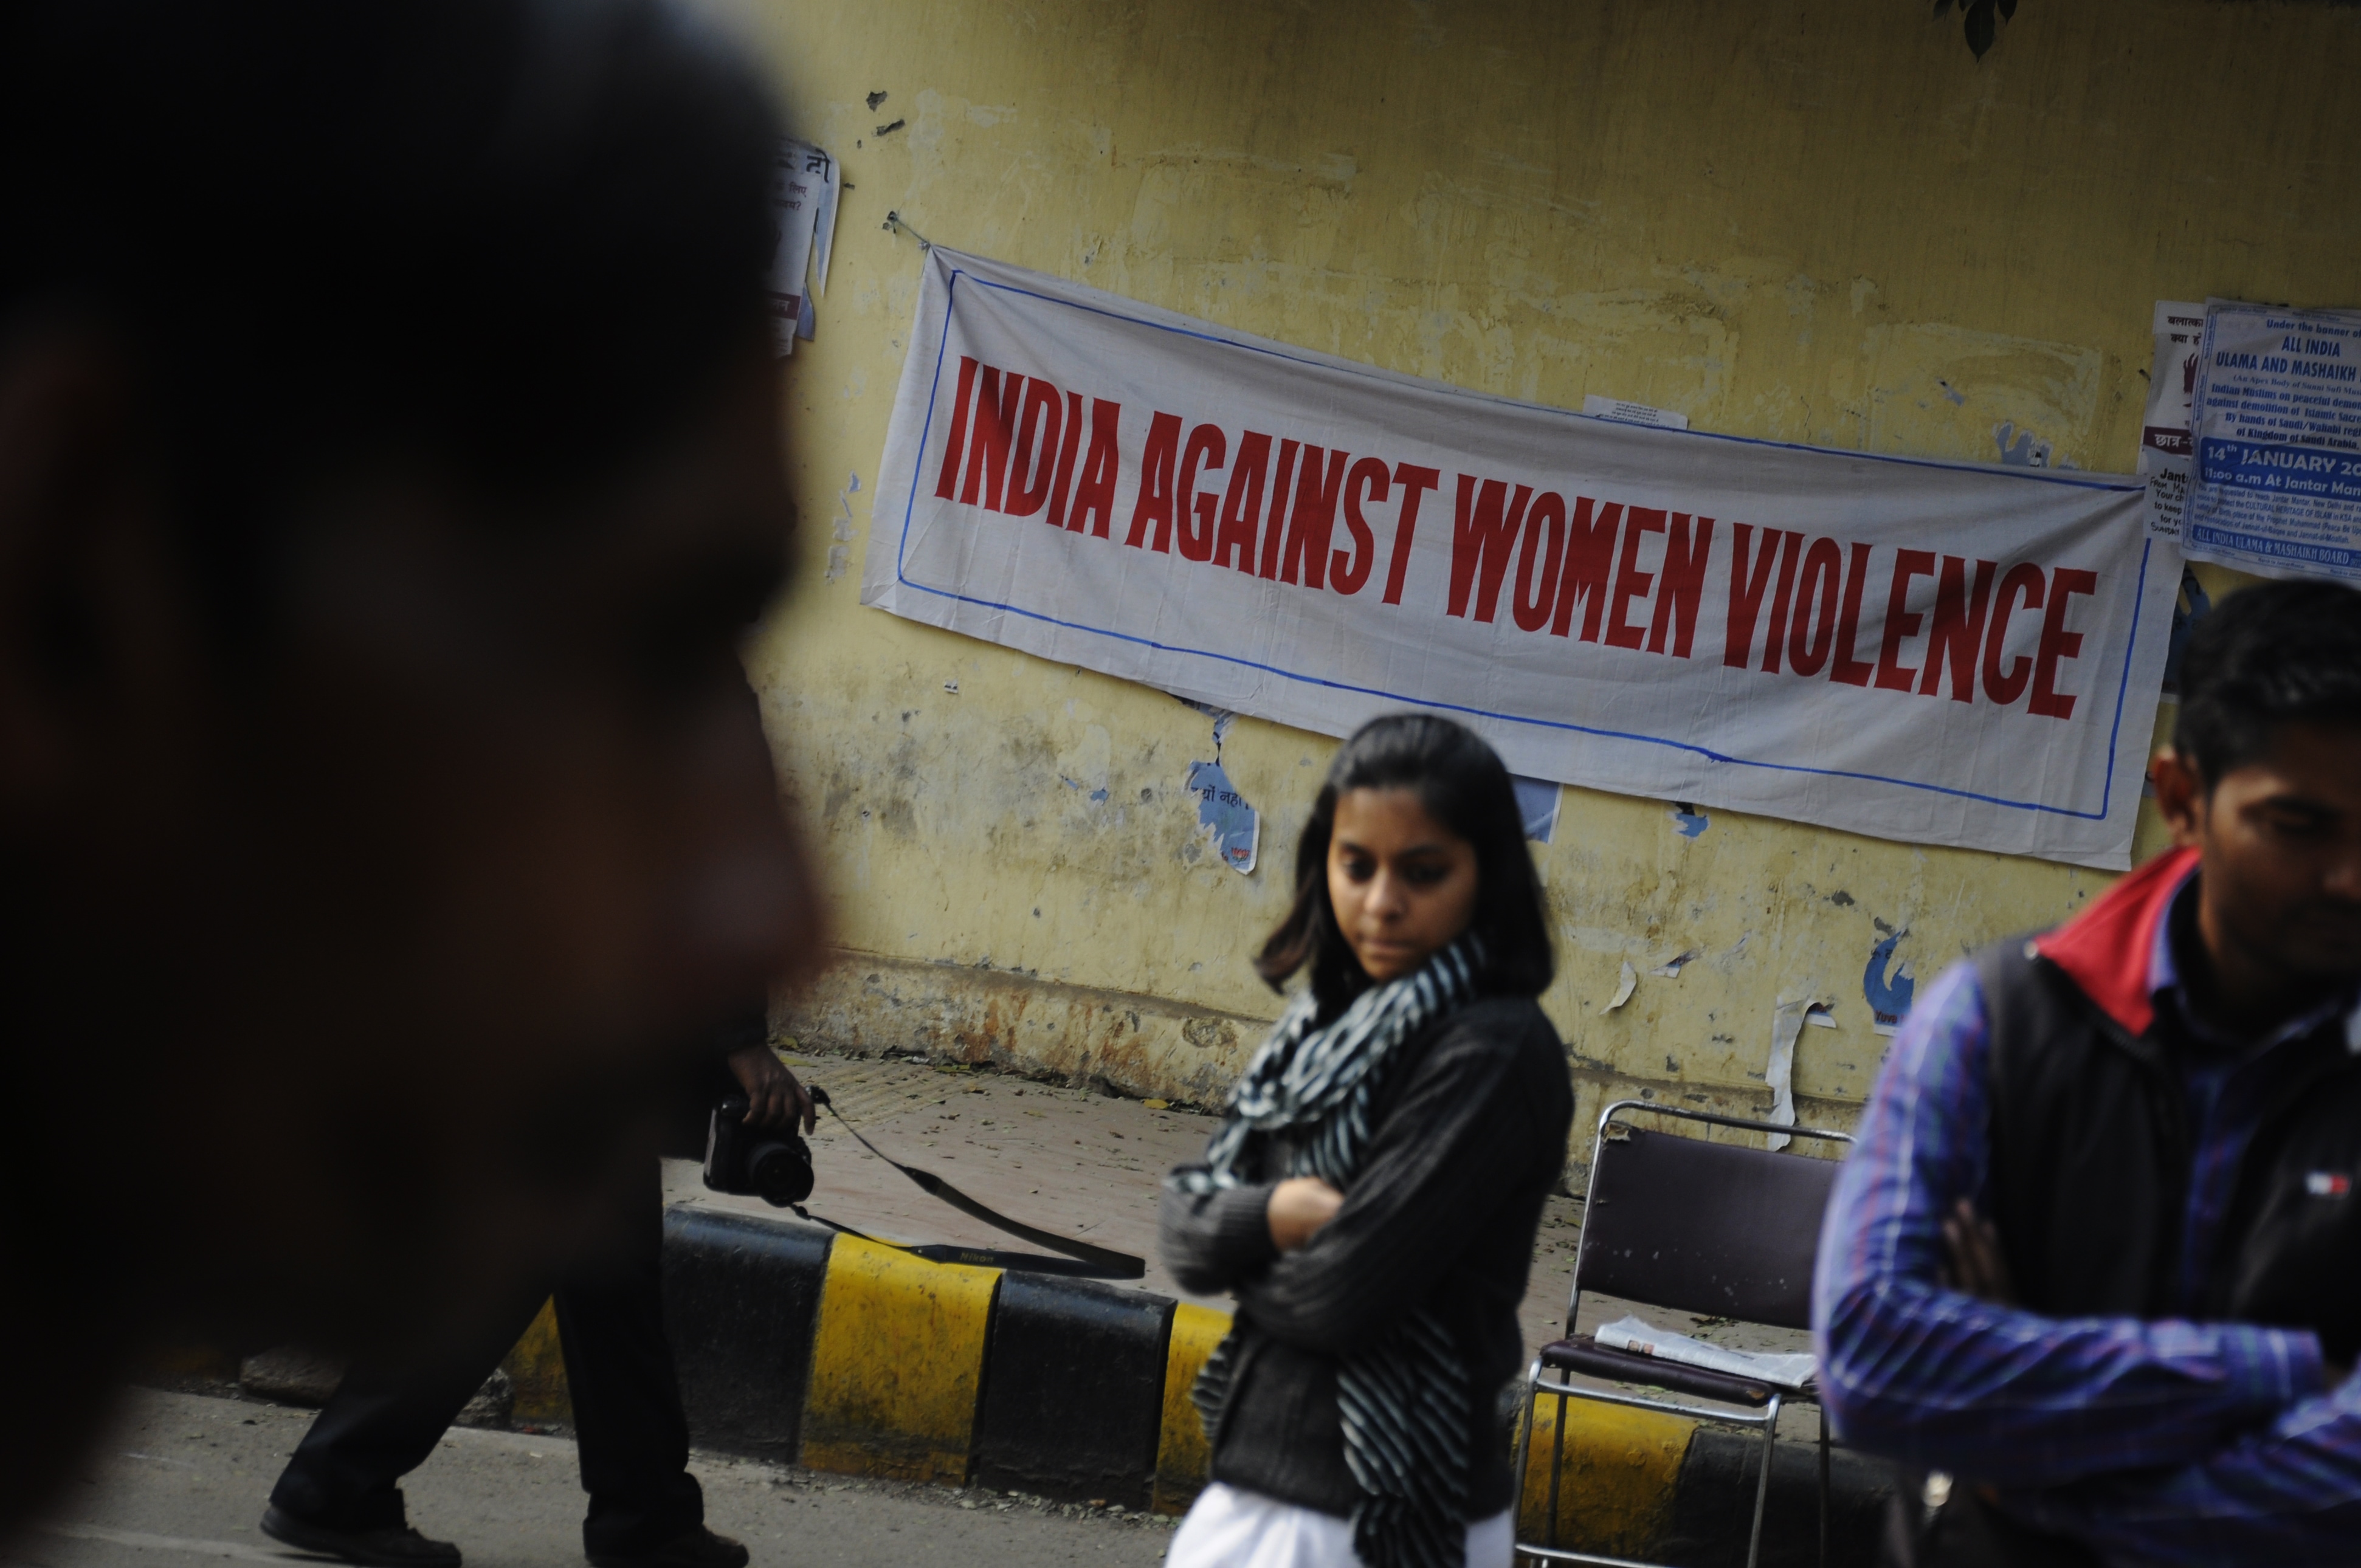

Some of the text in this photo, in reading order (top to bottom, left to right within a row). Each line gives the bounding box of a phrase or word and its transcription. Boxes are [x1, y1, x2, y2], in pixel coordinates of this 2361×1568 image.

[2170, 334, 2188, 343] क्या
[2266, 318, 2361, 338] Under the banner of
[2281, 335, 2340, 357] ALL INDIA
[2216, 351, 2357, 382] ULAMA AND MASHAIKH
[2211, 383, 2240, 395] Indian
[2242, 387, 2277, 400] Muslims
[2279, 392, 2290, 401] on
[2292, 394, 2331, 407] peaceful
[2250, 376, 2269, 385] Apex
[2271, 377, 2289, 388] Body
[2302, 382, 2324, 392] Sunni
[2207, 397, 2238, 408] against
[2241, 401, 2289, 414] demolition
[2290, 407, 2300, 416] of
[2304, 408, 2335, 420] Islamic
[2225, 411, 2236, 423] By
[2239, 413, 2265, 425] hands
[2267, 417, 2277, 427] of
[2278, 418, 2341, 435] Saudi/Wahabi
[2236, 427, 2359, 450] of Kingdom of Saudi Arabia.
[2207, 444, 2237, 461] 14th
[2241, 449, 2337, 473] JANUARY
[2204, 467, 2232, 481] 11:00
[2236, 473, 2261, 485] a.m
[2264, 474, 2282, 487] At
[2284, 476, 2328, 493] Jantar
[2156, 489, 2173, 500] Your
[2272, 495, 2289, 503] Jantar
[2327, 500, 2342, 509] Delhi
[2154, 501, 2182, 515] to keep
[2160, 514, 2171, 524] for
[2236, 500, 2244, 508] the
[2246, 501, 2275, 512] CULTURAL
[2275, 505, 2304, 517] HERITAGE
[2305, 509, 2314, 517] OF
[2314, 510, 2332, 520] ISLAM
[2339, 514, 2352, 522] KSA
[935, 356, 2098, 720] INDIA AGAINST WOMEN VIOLENCE
[2196, 529, 2211, 542] ALL
[2213, 531, 2233, 545] INDIA
[2235, 535, 2263, 551] ULAMA
[2265, 542, 2273, 554] &
[2274, 542, 2317, 560] MASHAIKH
[2318, 548, 2349, 564] BOARD
[960, 1251, 994, 1264] Nikon
